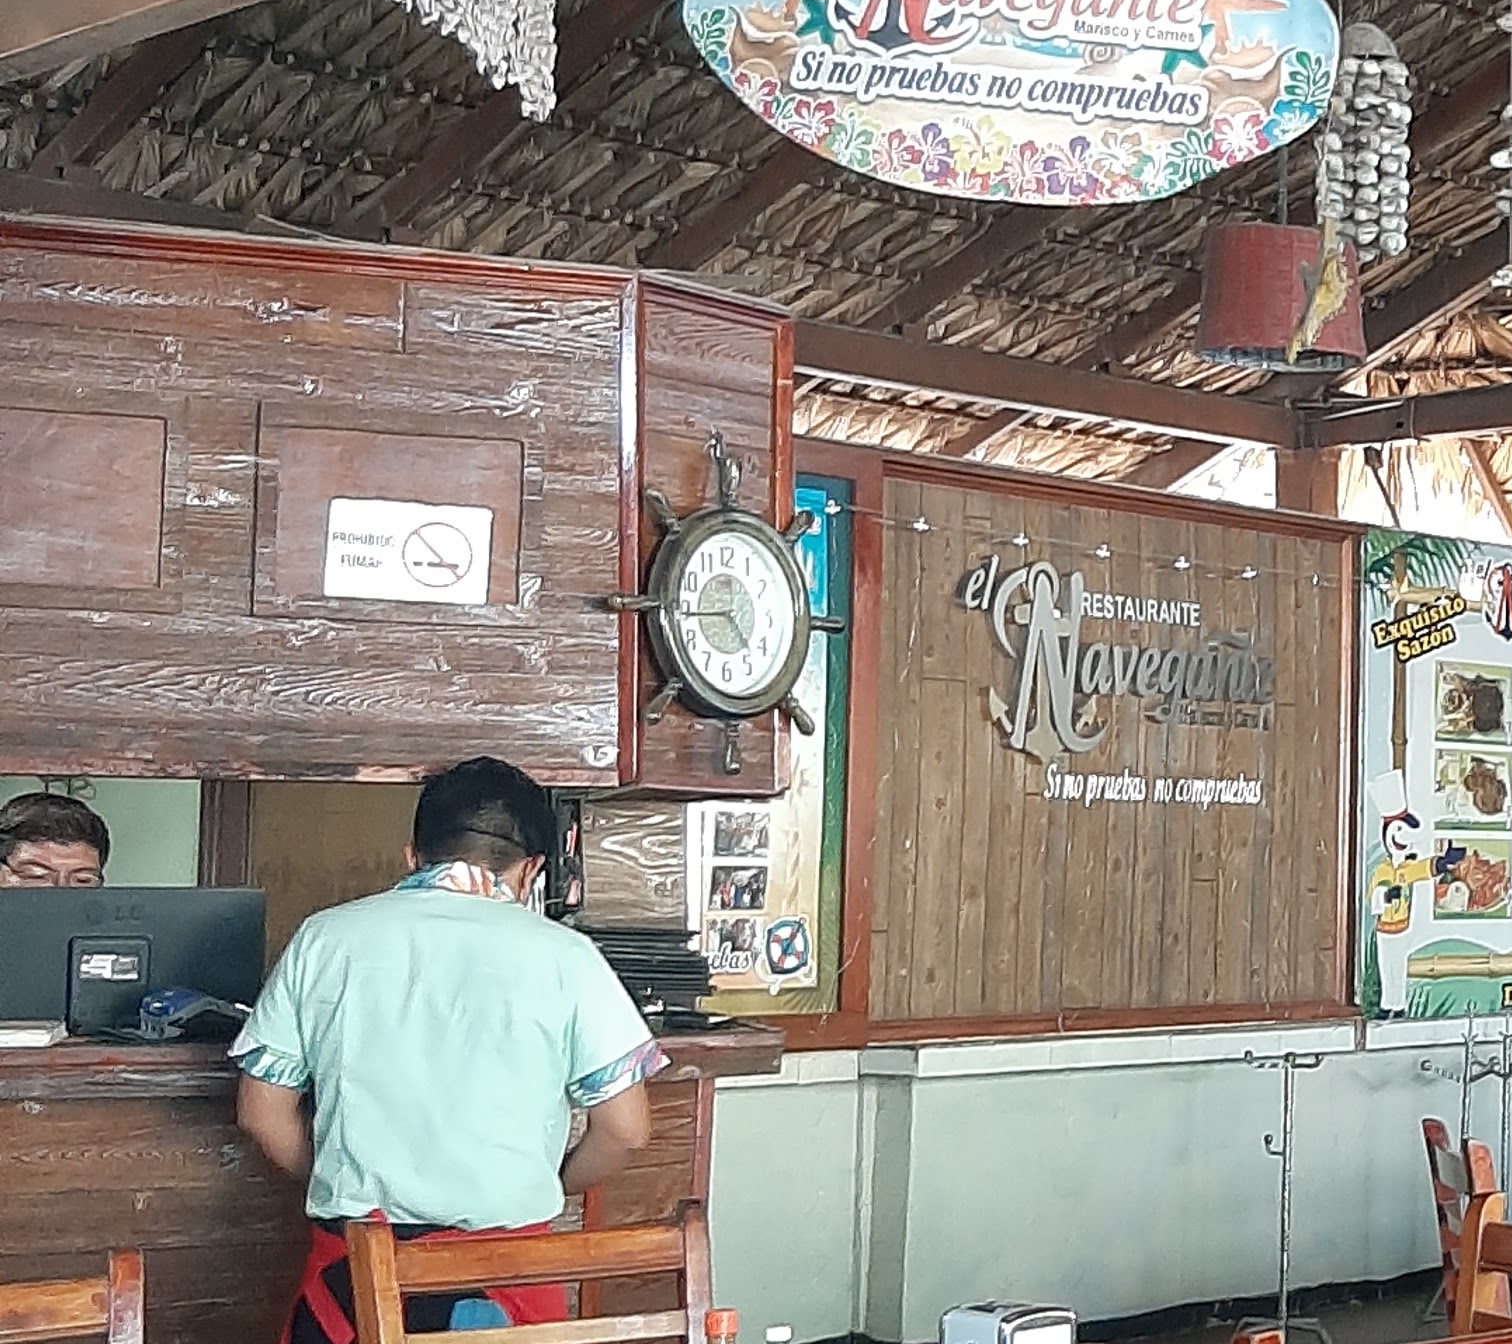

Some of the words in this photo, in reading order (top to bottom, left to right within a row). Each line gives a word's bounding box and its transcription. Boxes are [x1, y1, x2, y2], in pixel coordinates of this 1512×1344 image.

[1133, 28, 1141, 41] y
[797, 52, 822, 82] Si
[827, 60, 859, 85] no
[864, 62, 981, 97] pruebas
[987, 74, 1021, 100] no
[1027, 77, 1202, 117] compruebas
[965, 553, 1000, 611] el
[1081, 591, 1200, 627] RESTAURANTE
[1373, 597, 1465, 646] Exquisito
[1397, 626, 1455, 660] Sazón
[1062, 772, 1084, 800] no
[1085, 768, 1148, 808] pruebas
[1153, 776, 1173, 803] no
[1175, 773, 1264, 810] compruebas
